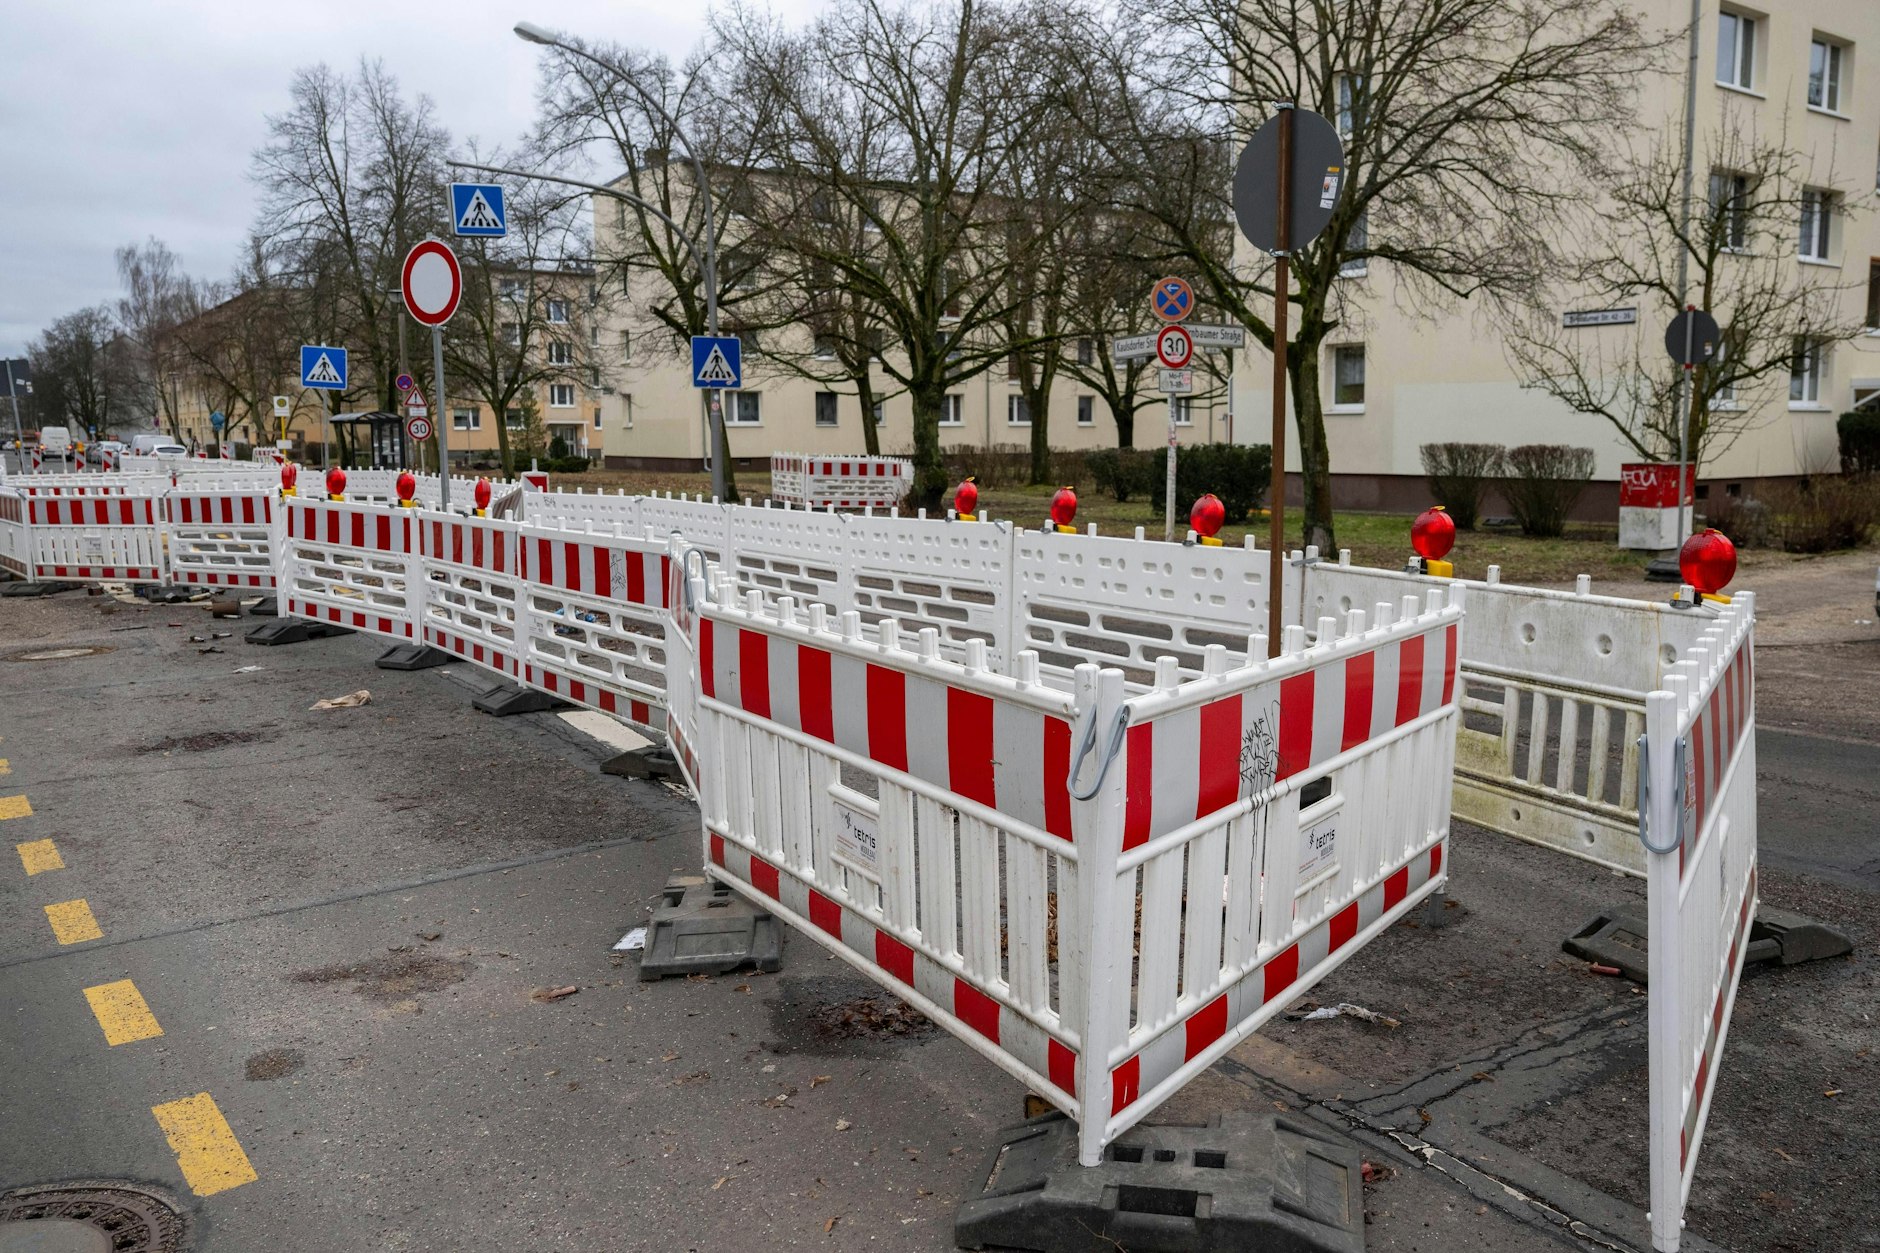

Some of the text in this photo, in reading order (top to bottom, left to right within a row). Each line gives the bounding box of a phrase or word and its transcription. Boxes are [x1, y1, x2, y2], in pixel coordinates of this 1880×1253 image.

[1189, 328, 1241, 343] rnbaumer Straße
[1116, 337, 1157, 353] Kaulsdorfer Stra
[1164, 337, 1185, 357] 30
[412, 423, 427, 434] 30
[853, 825, 876, 849] tetris
[1316, 829, 1335, 849] tetris
